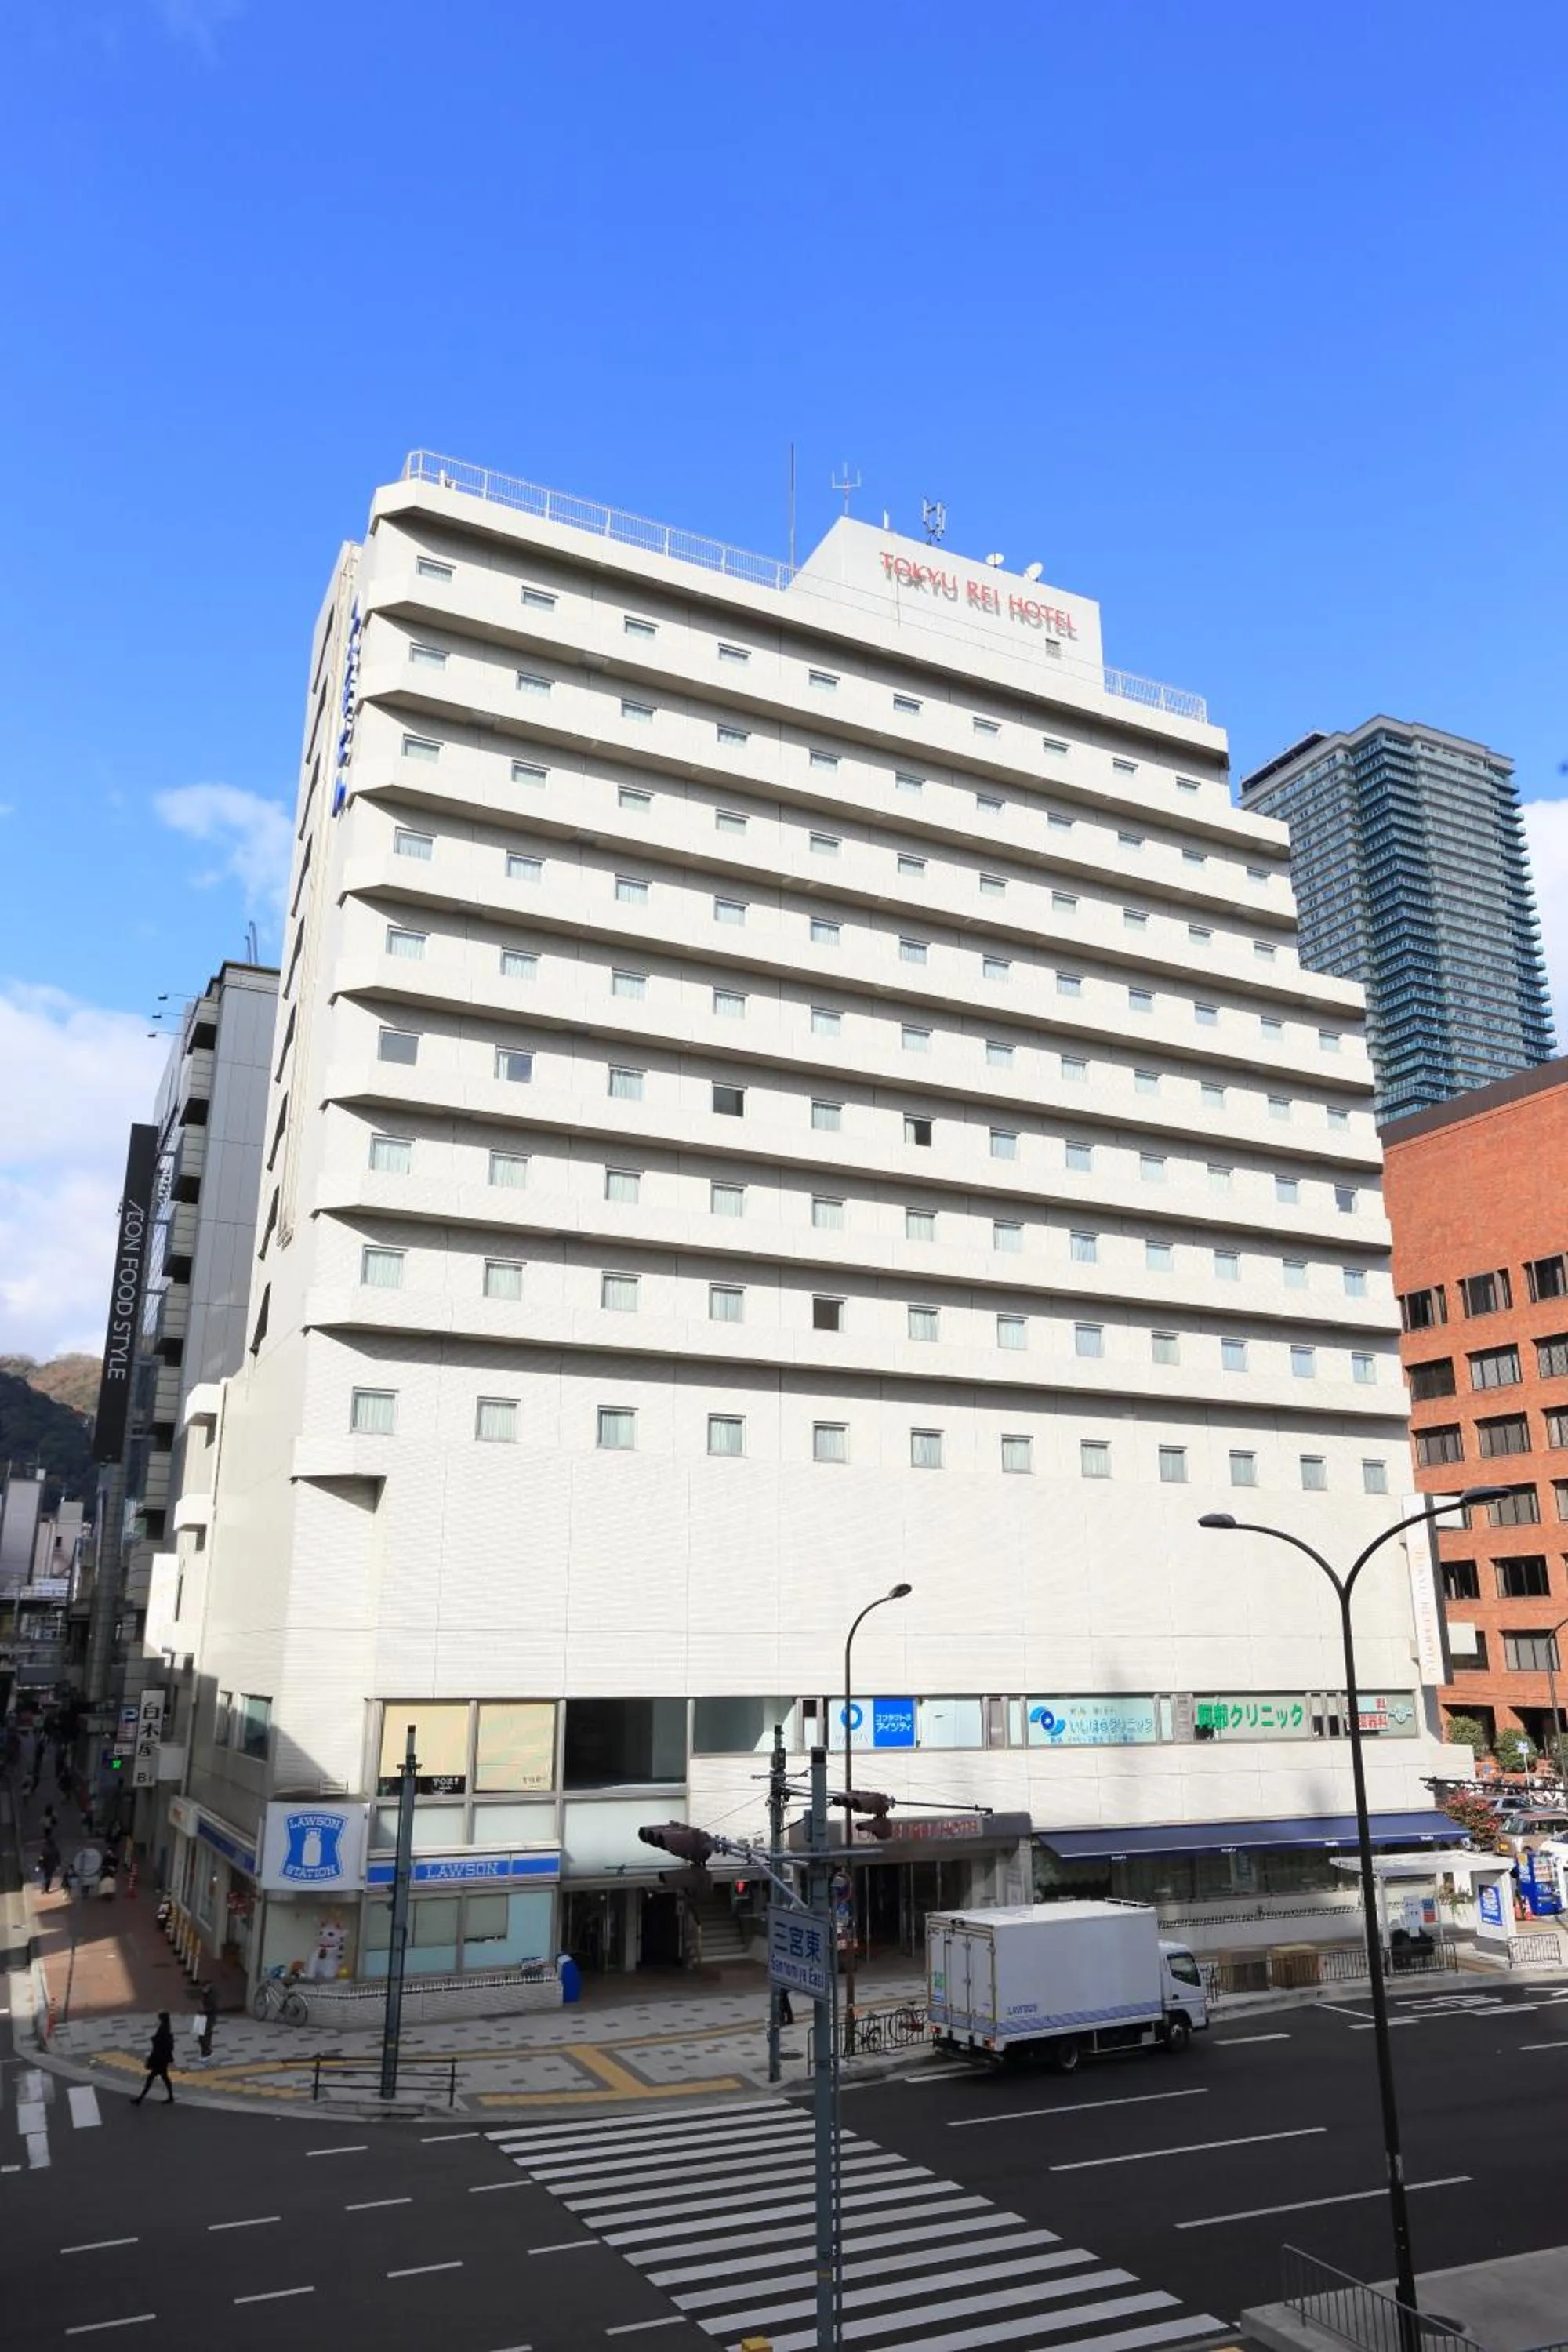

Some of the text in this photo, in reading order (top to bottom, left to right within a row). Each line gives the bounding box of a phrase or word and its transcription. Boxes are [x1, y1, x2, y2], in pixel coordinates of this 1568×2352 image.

[879, 551, 1077, 633] TOKYU REI HOTEL
[115, 1258, 138, 1316] FOOD
[107, 1320, 132, 1381] STYLE
[288, 1815, 342, 1829] LAWSON
[285, 1864, 337, 1878] STATION
[425, 1861, 499, 1879] LAWSON
[773, 1920, 822, 1964] 三宮東
